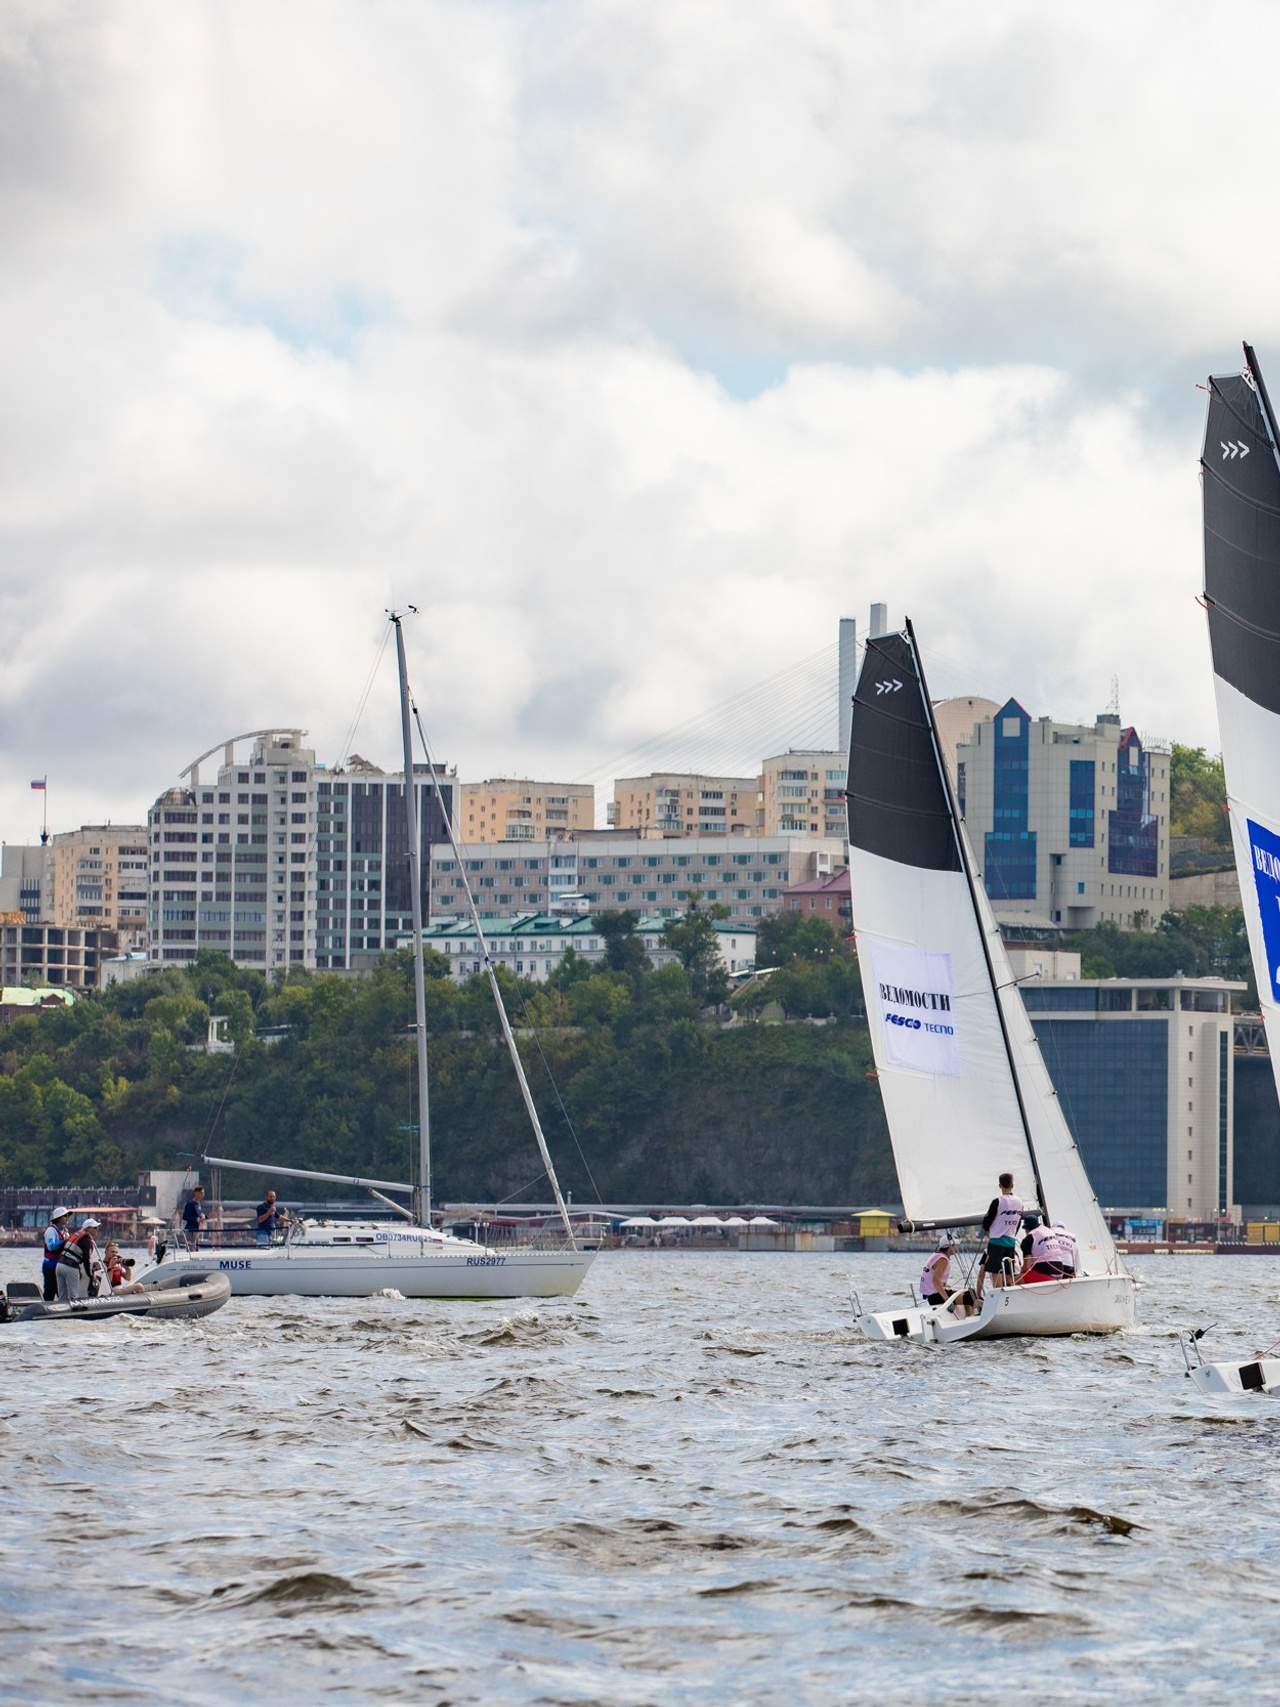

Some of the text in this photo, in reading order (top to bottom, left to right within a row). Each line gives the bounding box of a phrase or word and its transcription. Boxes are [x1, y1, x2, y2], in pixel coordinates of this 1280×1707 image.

[879, 983, 951, 1011] ВЕДОМОСТИ
[885, 1013, 954, 1035] FESCO TECNO
[219, 1260, 252, 1269] MUSE
[466, 1257, 506, 1266] RUS2977
[1004, 1296, 1010, 1307] 5
